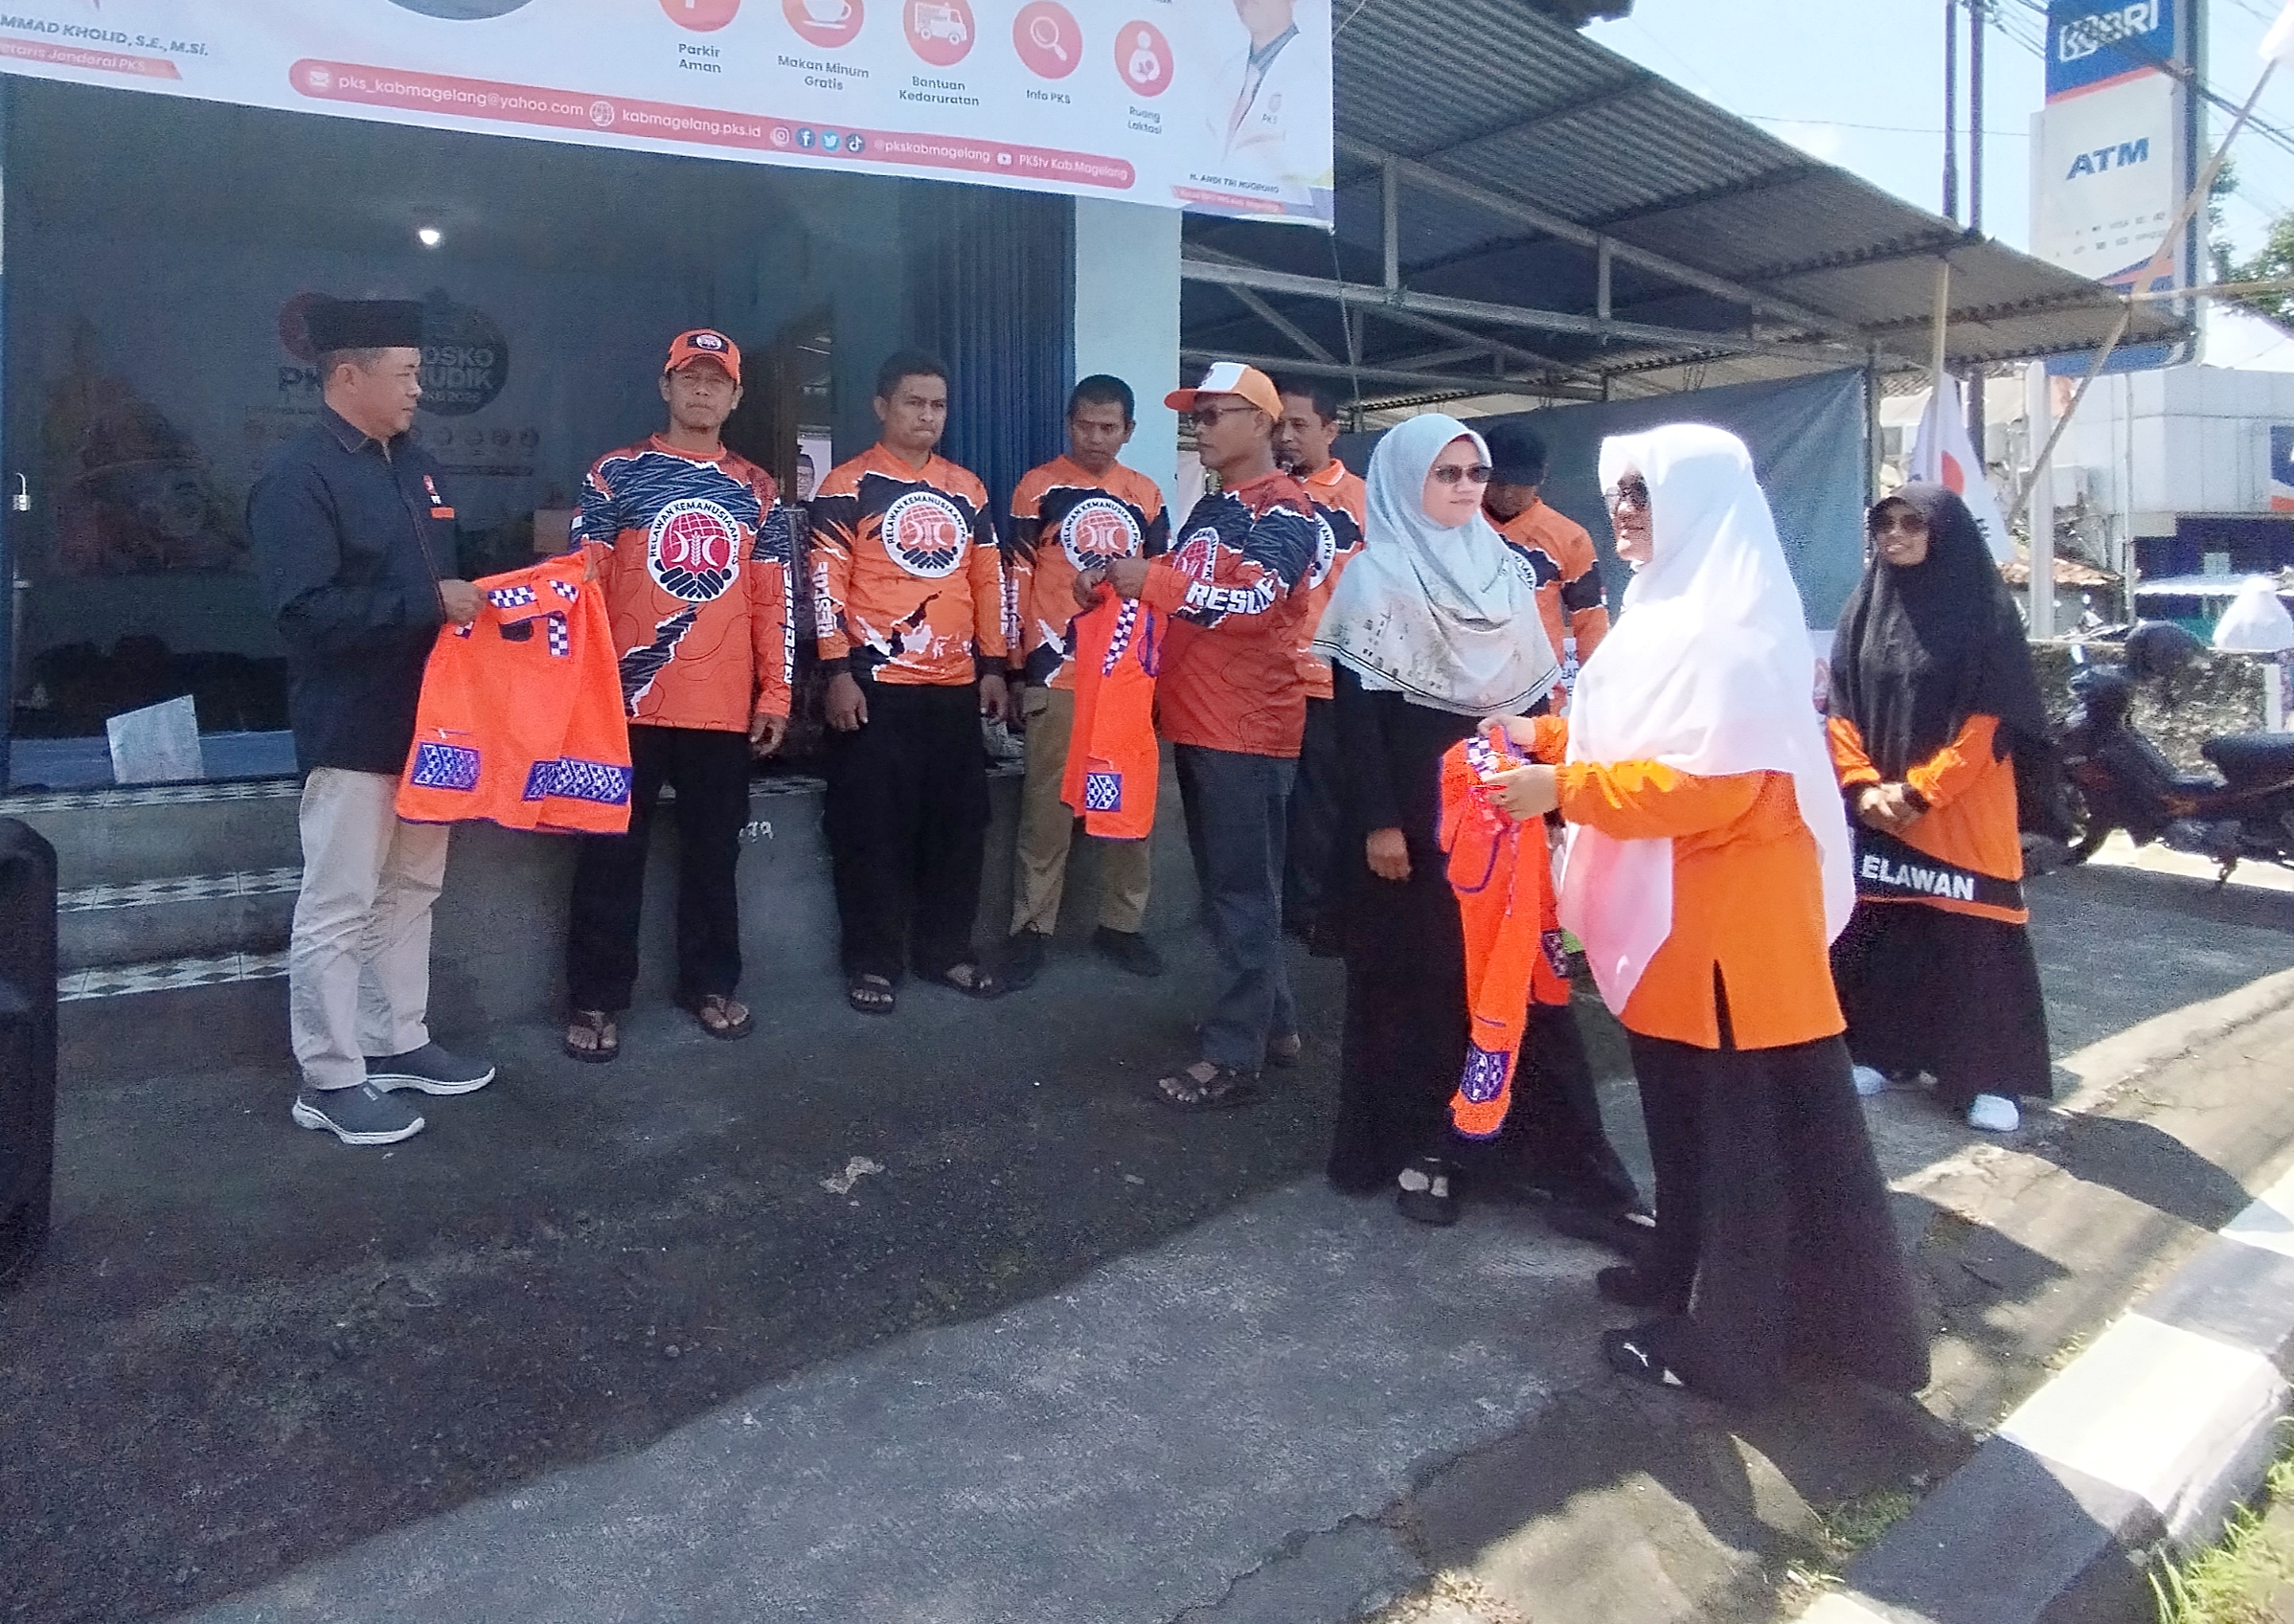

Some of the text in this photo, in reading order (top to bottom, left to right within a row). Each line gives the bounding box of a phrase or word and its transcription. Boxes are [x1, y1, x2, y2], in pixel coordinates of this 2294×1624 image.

[62, 24, 133, 47] KHOLID,
[677, 42, 721, 59] Parkir
[119, 58, 146, 72] PKS
[678, 57, 722, 75] Aman
[777, 54, 870, 79] Makan Minum
[804, 76, 844, 91] Gratis
[911, 75, 966, 91] Bantuan
[338, 75, 584, 117] pks_kabmagelang@yahoo.com
[898, 89, 980, 106] Kedaruratan
[1026, 88, 1072, 104] Info PKS
[622, 108, 761, 139] kabmagelang.pks.id
[1128, 105, 1161, 124] Ruang
[1127, 120, 1163, 135] Laktasi
[874, 138, 991, 163] @pkskabmagelang
[2065, 137, 2149, 180] ATM
[1051, 157, 1128, 181] Kab.Magelang
[420, 346, 494, 368] OSKO
[886, 503, 905, 545] RELAWAN
[902, 495, 964, 526] KEMANUSIAAN
[1063, 508, 1082, 549] RELAWAN
[1080, 501, 1137, 530] KEMANUSIAAN
[1860, 853, 1975, 901] ELAWAN
